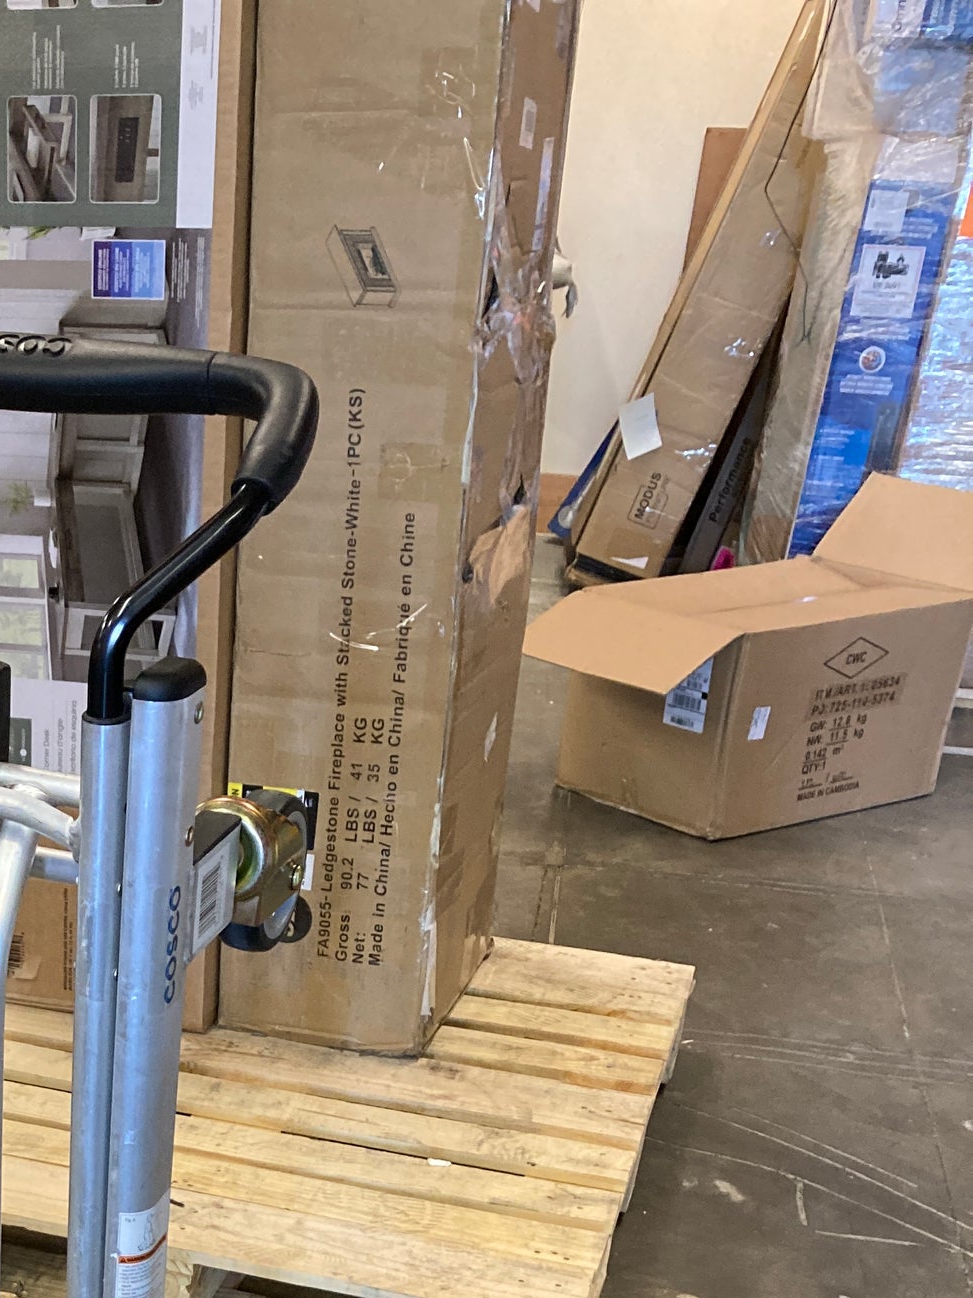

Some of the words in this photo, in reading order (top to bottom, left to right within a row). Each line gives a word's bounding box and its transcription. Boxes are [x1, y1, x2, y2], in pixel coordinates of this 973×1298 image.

[634, 472, 662, 519] MODUS
[399, 513, 415, 566] Chine
[400, 574, 413, 597] en
[336, 596, 354, 666] Stacked
[846, 651, 867, 665] CWC
[336, 673, 348, 706] with
[353, 717, 367, 743] KG
[371, 718, 385, 744] KG
[388, 689, 406, 747] China/
[328, 713, 345, 790] Fireplace
[387, 755, 399, 775] en
[350, 763, 363, 780] 41
[367, 764, 380, 782] 35
[345, 808, 360, 842] LBS
[380, 782, 398, 836] Hecho
[362, 809, 377, 843] LBS
[321, 797, 339, 892] Ledgestone
[340, 857, 354, 890] 90.2
[356, 873, 369, 890] 77
[374, 841, 392, 897] China/
[372, 903, 385, 917] in
[164, 885, 182, 1004] COSCO
[352, 932, 366, 964] Net:
[368, 924, 384, 966] Made
